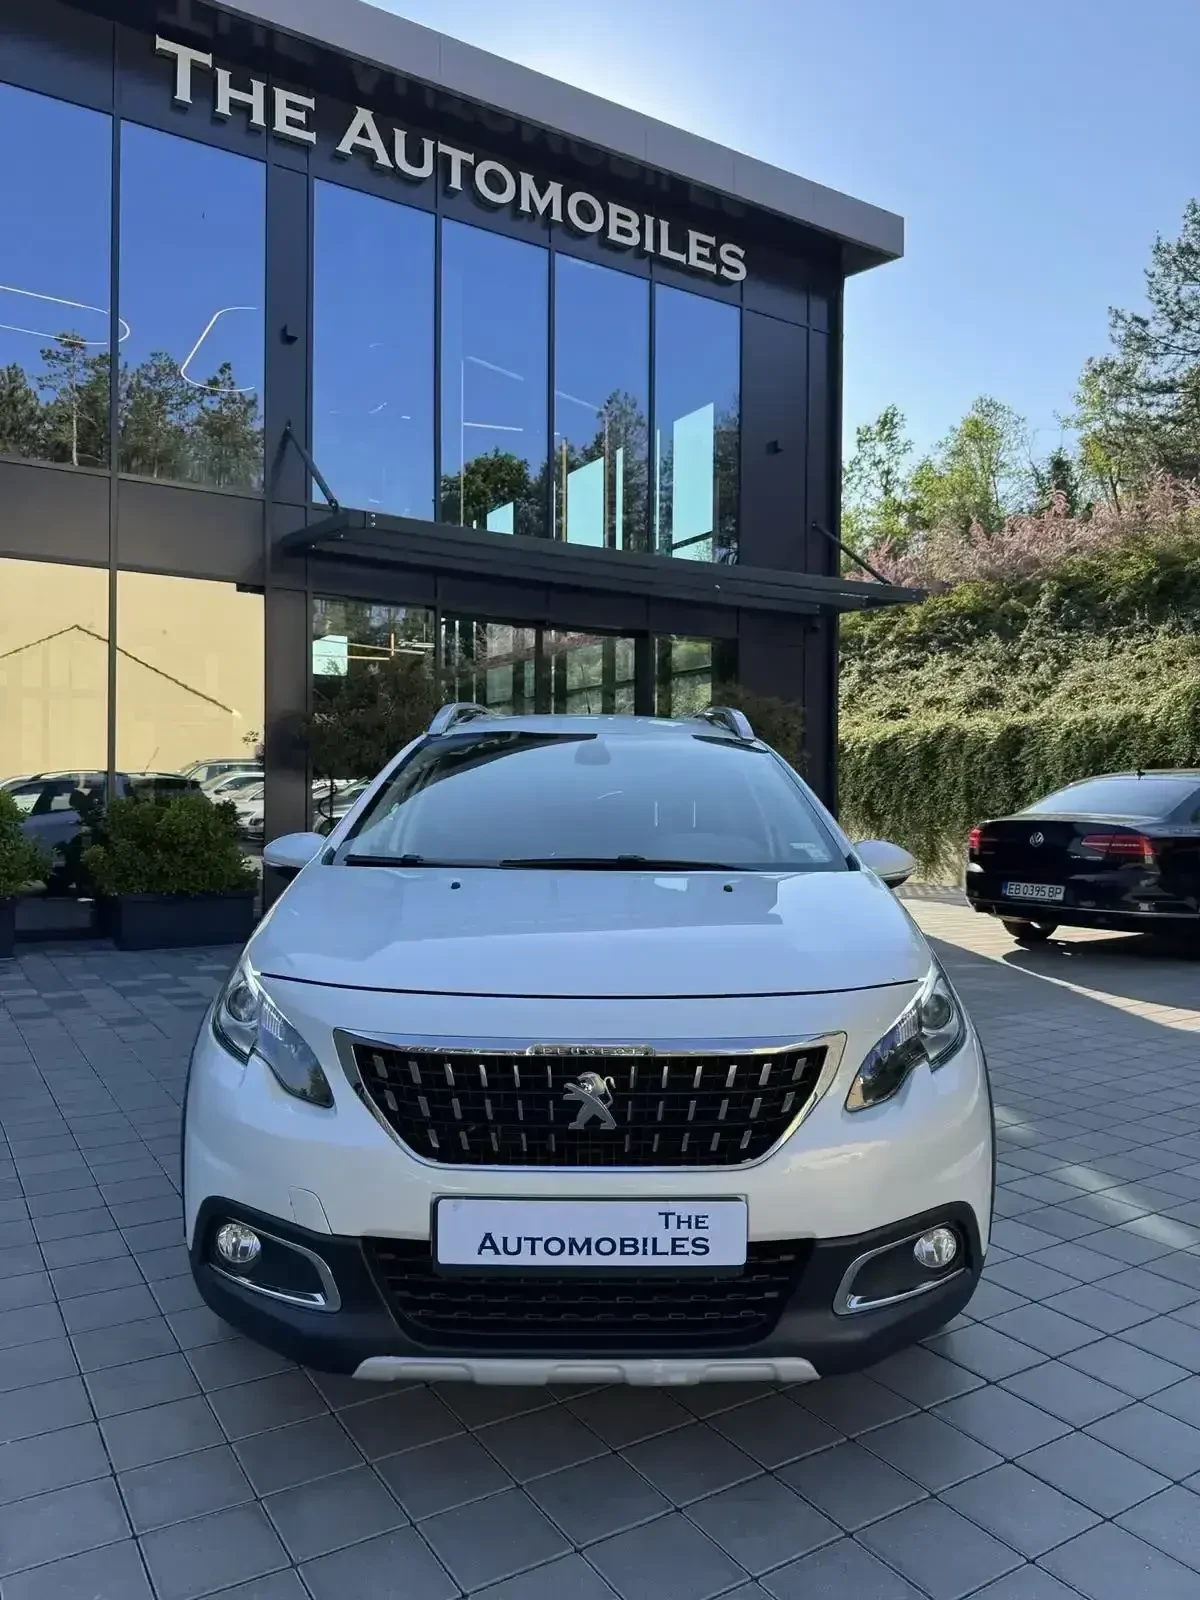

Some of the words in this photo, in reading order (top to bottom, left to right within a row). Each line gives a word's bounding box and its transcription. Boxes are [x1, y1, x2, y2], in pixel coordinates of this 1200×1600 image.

[155, 34, 316, 145] THE
[335, 105, 748, 282] AUTOMOBILES
[1008, 883, 1021, 895] EB
[1022, 884, 1046, 897] 0395
[542, 1047, 640, 1055] PEUGEOT
[658, 1211, 709, 1230] THE
[477, 1232, 710, 1256] AUTOMOBILES
